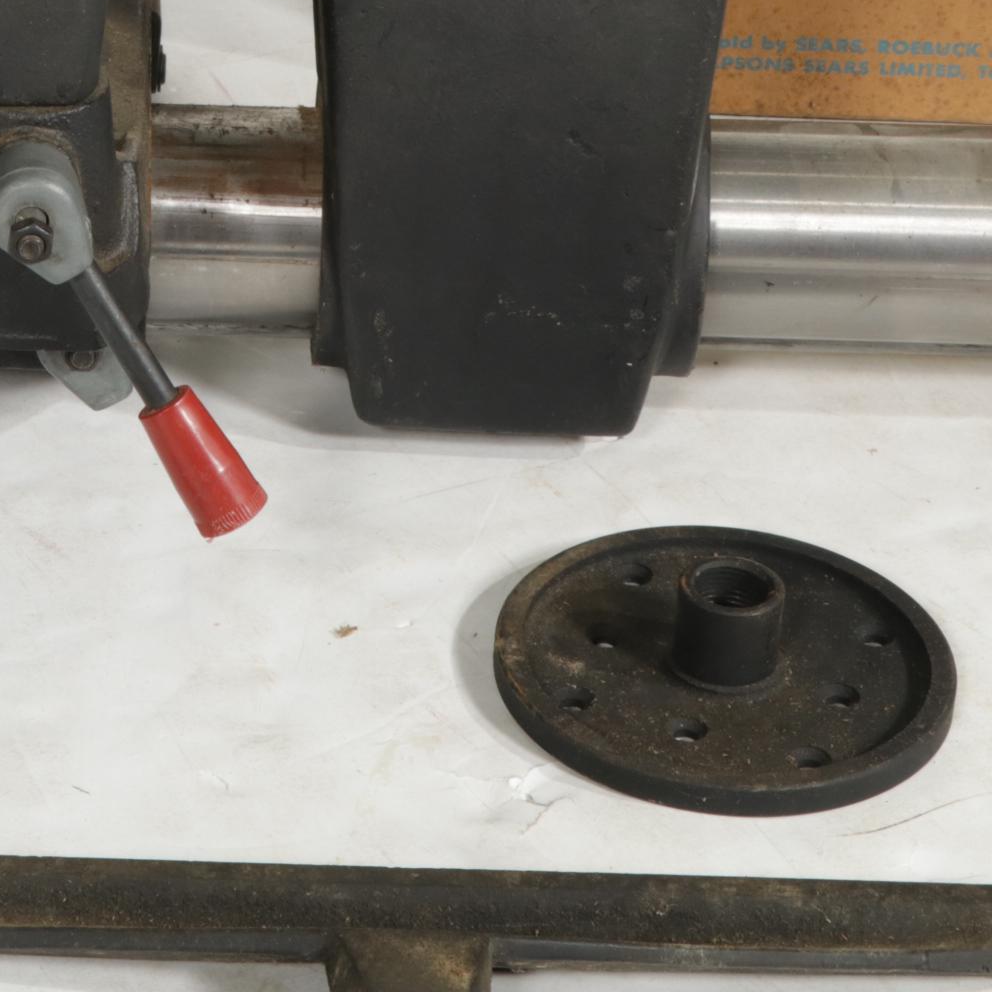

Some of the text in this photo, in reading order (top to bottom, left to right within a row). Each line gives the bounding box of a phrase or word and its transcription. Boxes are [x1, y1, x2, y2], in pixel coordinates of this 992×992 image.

[761, 36, 786, 55] by
[877, 39, 982, 60] ROEBUCK
[718, 57, 795, 74] PSONS
[803, 60, 870, 78] SEARS
